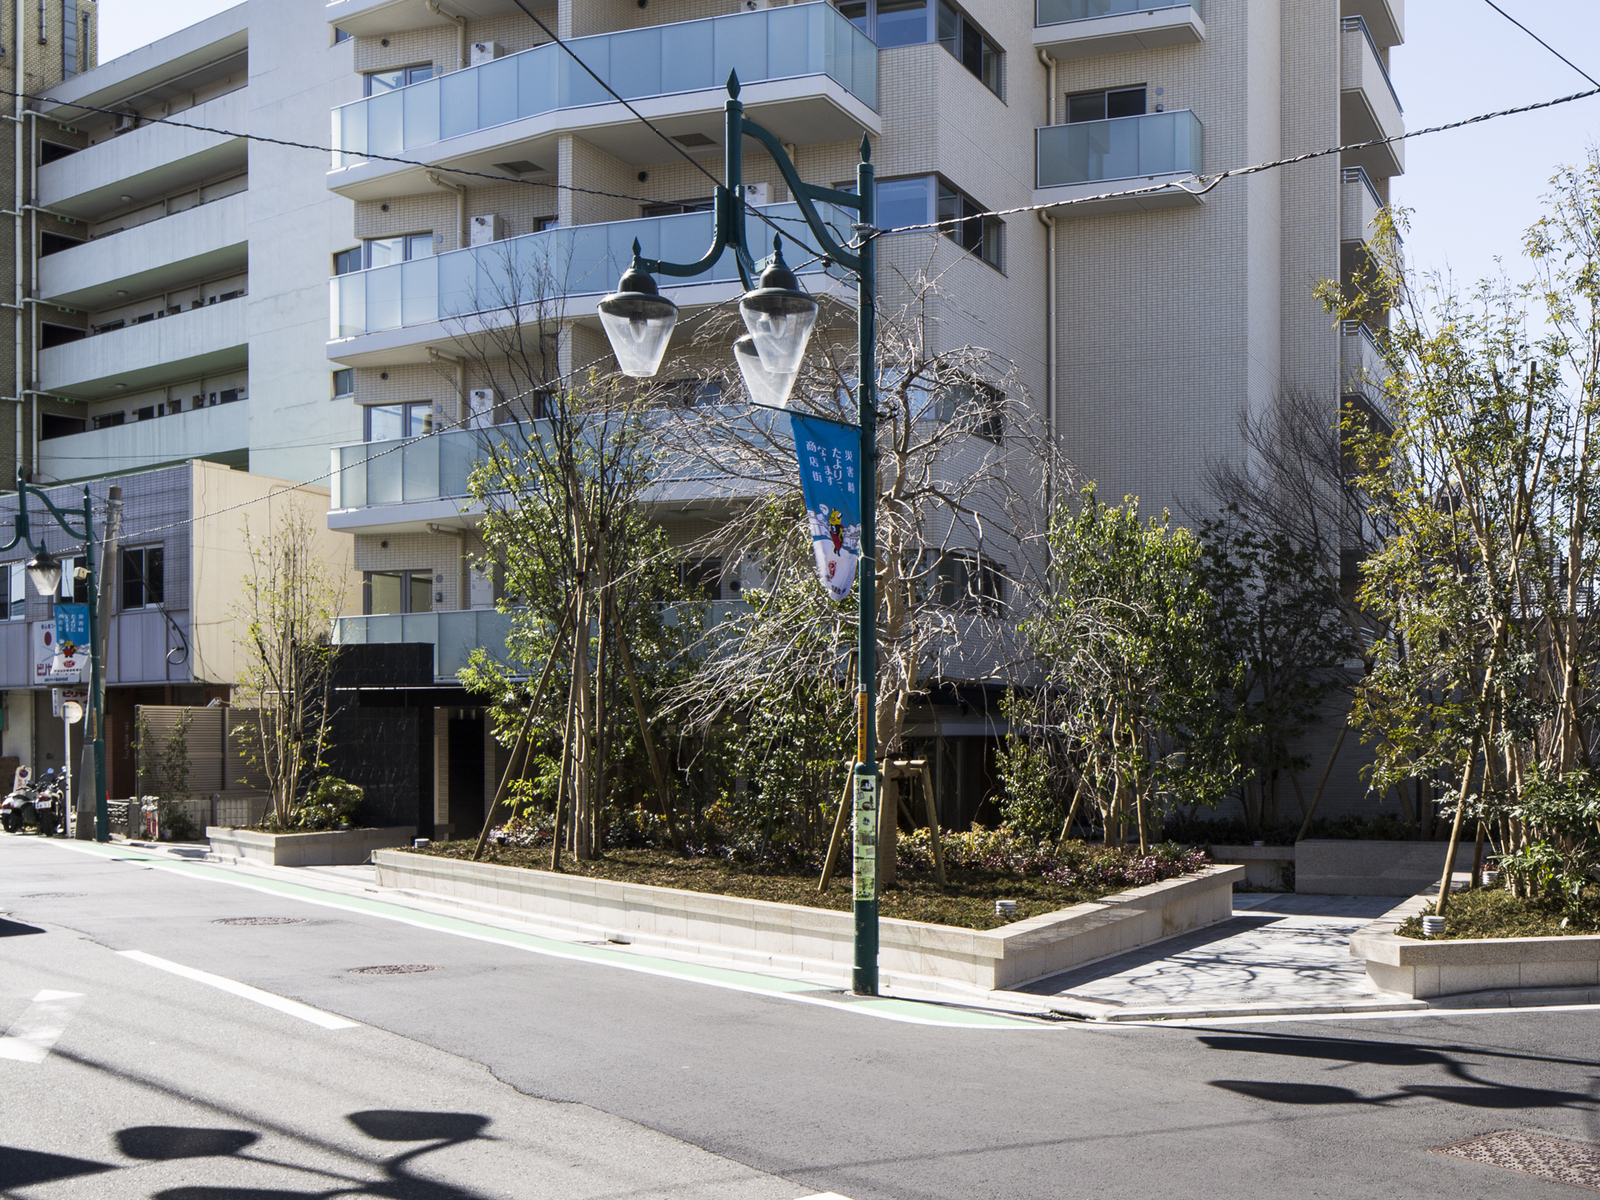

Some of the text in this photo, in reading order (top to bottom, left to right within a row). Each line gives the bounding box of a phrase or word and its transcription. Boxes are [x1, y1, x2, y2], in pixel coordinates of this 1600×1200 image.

[805, 440, 823, 483] 商店街
[817, 445, 834, 486] なります
[831, 447, 843, 491] たよりに
[844, 449, 856, 494] 災害時
